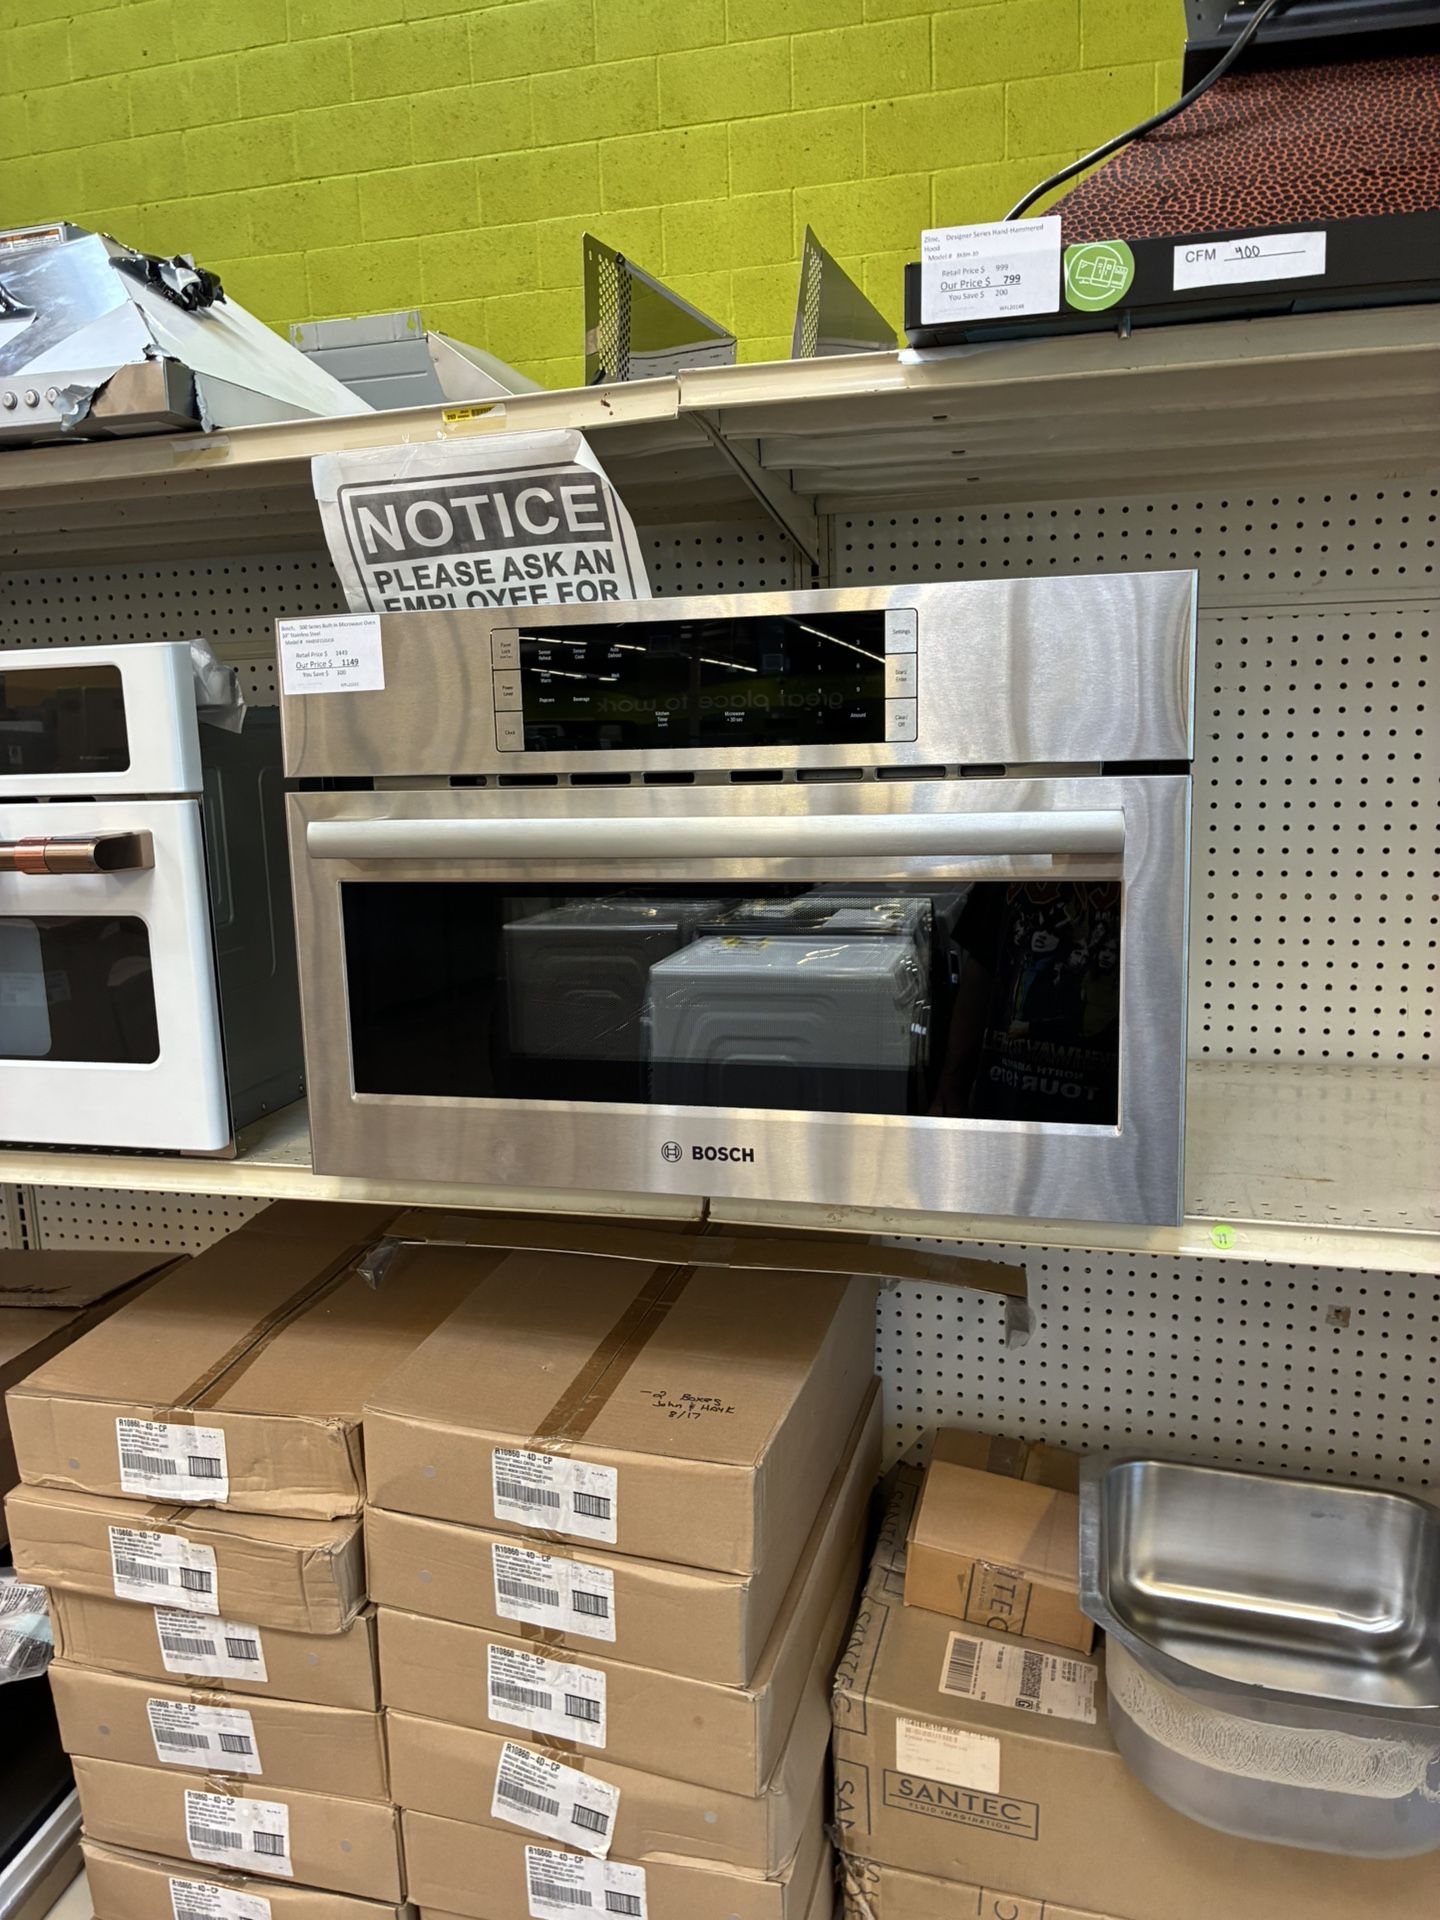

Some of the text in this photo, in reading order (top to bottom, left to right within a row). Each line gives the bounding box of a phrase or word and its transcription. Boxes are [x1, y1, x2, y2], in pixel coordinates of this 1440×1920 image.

[946, 232, 972, 241] Designer
[973, 230, 991, 238] Series
[1185, 245, 1260, 263] CFM 400
[942, 264, 1009, 277] Retail Price $ 999
[940, 274, 1021, 291] Our Price $ 799
[949, 293, 962, 301] You
[963, 292, 978, 300] Save
[995, 289, 1008, 297] 200
[357, 484, 605, 554] NOTICE
[373, 549, 615, 594] PLEASE ASK AN
[384, 579, 620, 612] EMPLOYEE FOR
[296, 658, 359, 669] Our Price $ 1149
[692, 1146, 754, 1162] BOSCH
[668, 1411, 701, 1419] 8/17
[899, 1778, 1022, 1821] SANTEC
[908, 1802, 937, 1813] FLUID
[940, 1810, 1010, 1831] IMAGINATION
